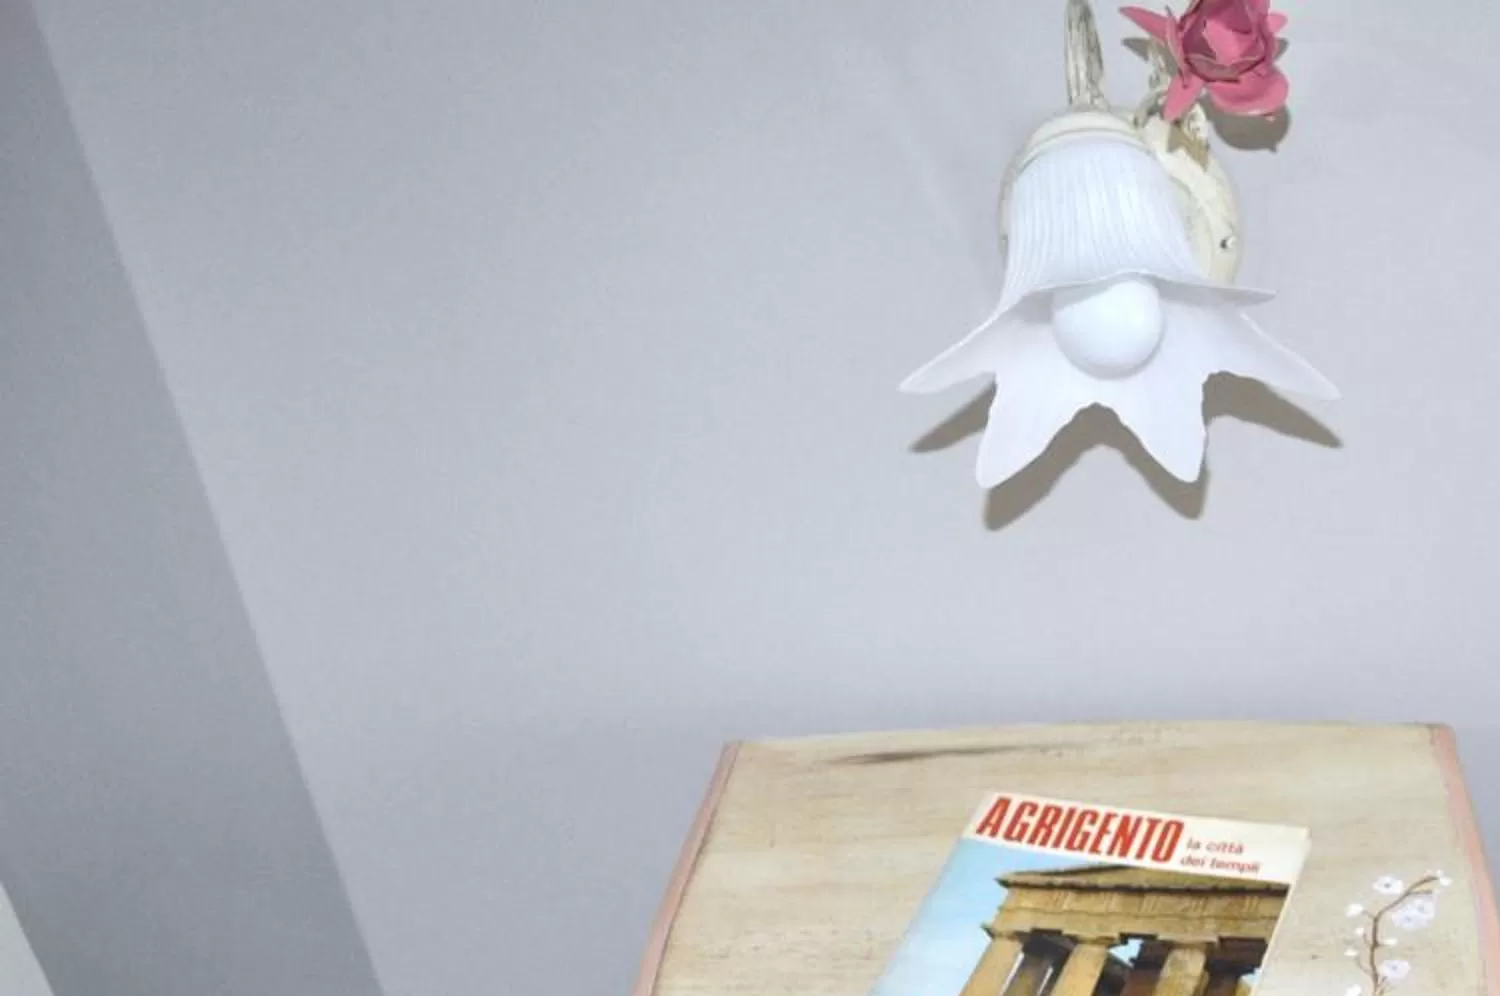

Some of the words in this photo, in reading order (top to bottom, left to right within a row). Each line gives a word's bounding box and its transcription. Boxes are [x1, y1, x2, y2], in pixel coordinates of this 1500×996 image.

[976, 796, 1184, 864] AGRIGENTO
[1186, 837, 1201, 850] la
[1181, 855, 1206, 867] dei
